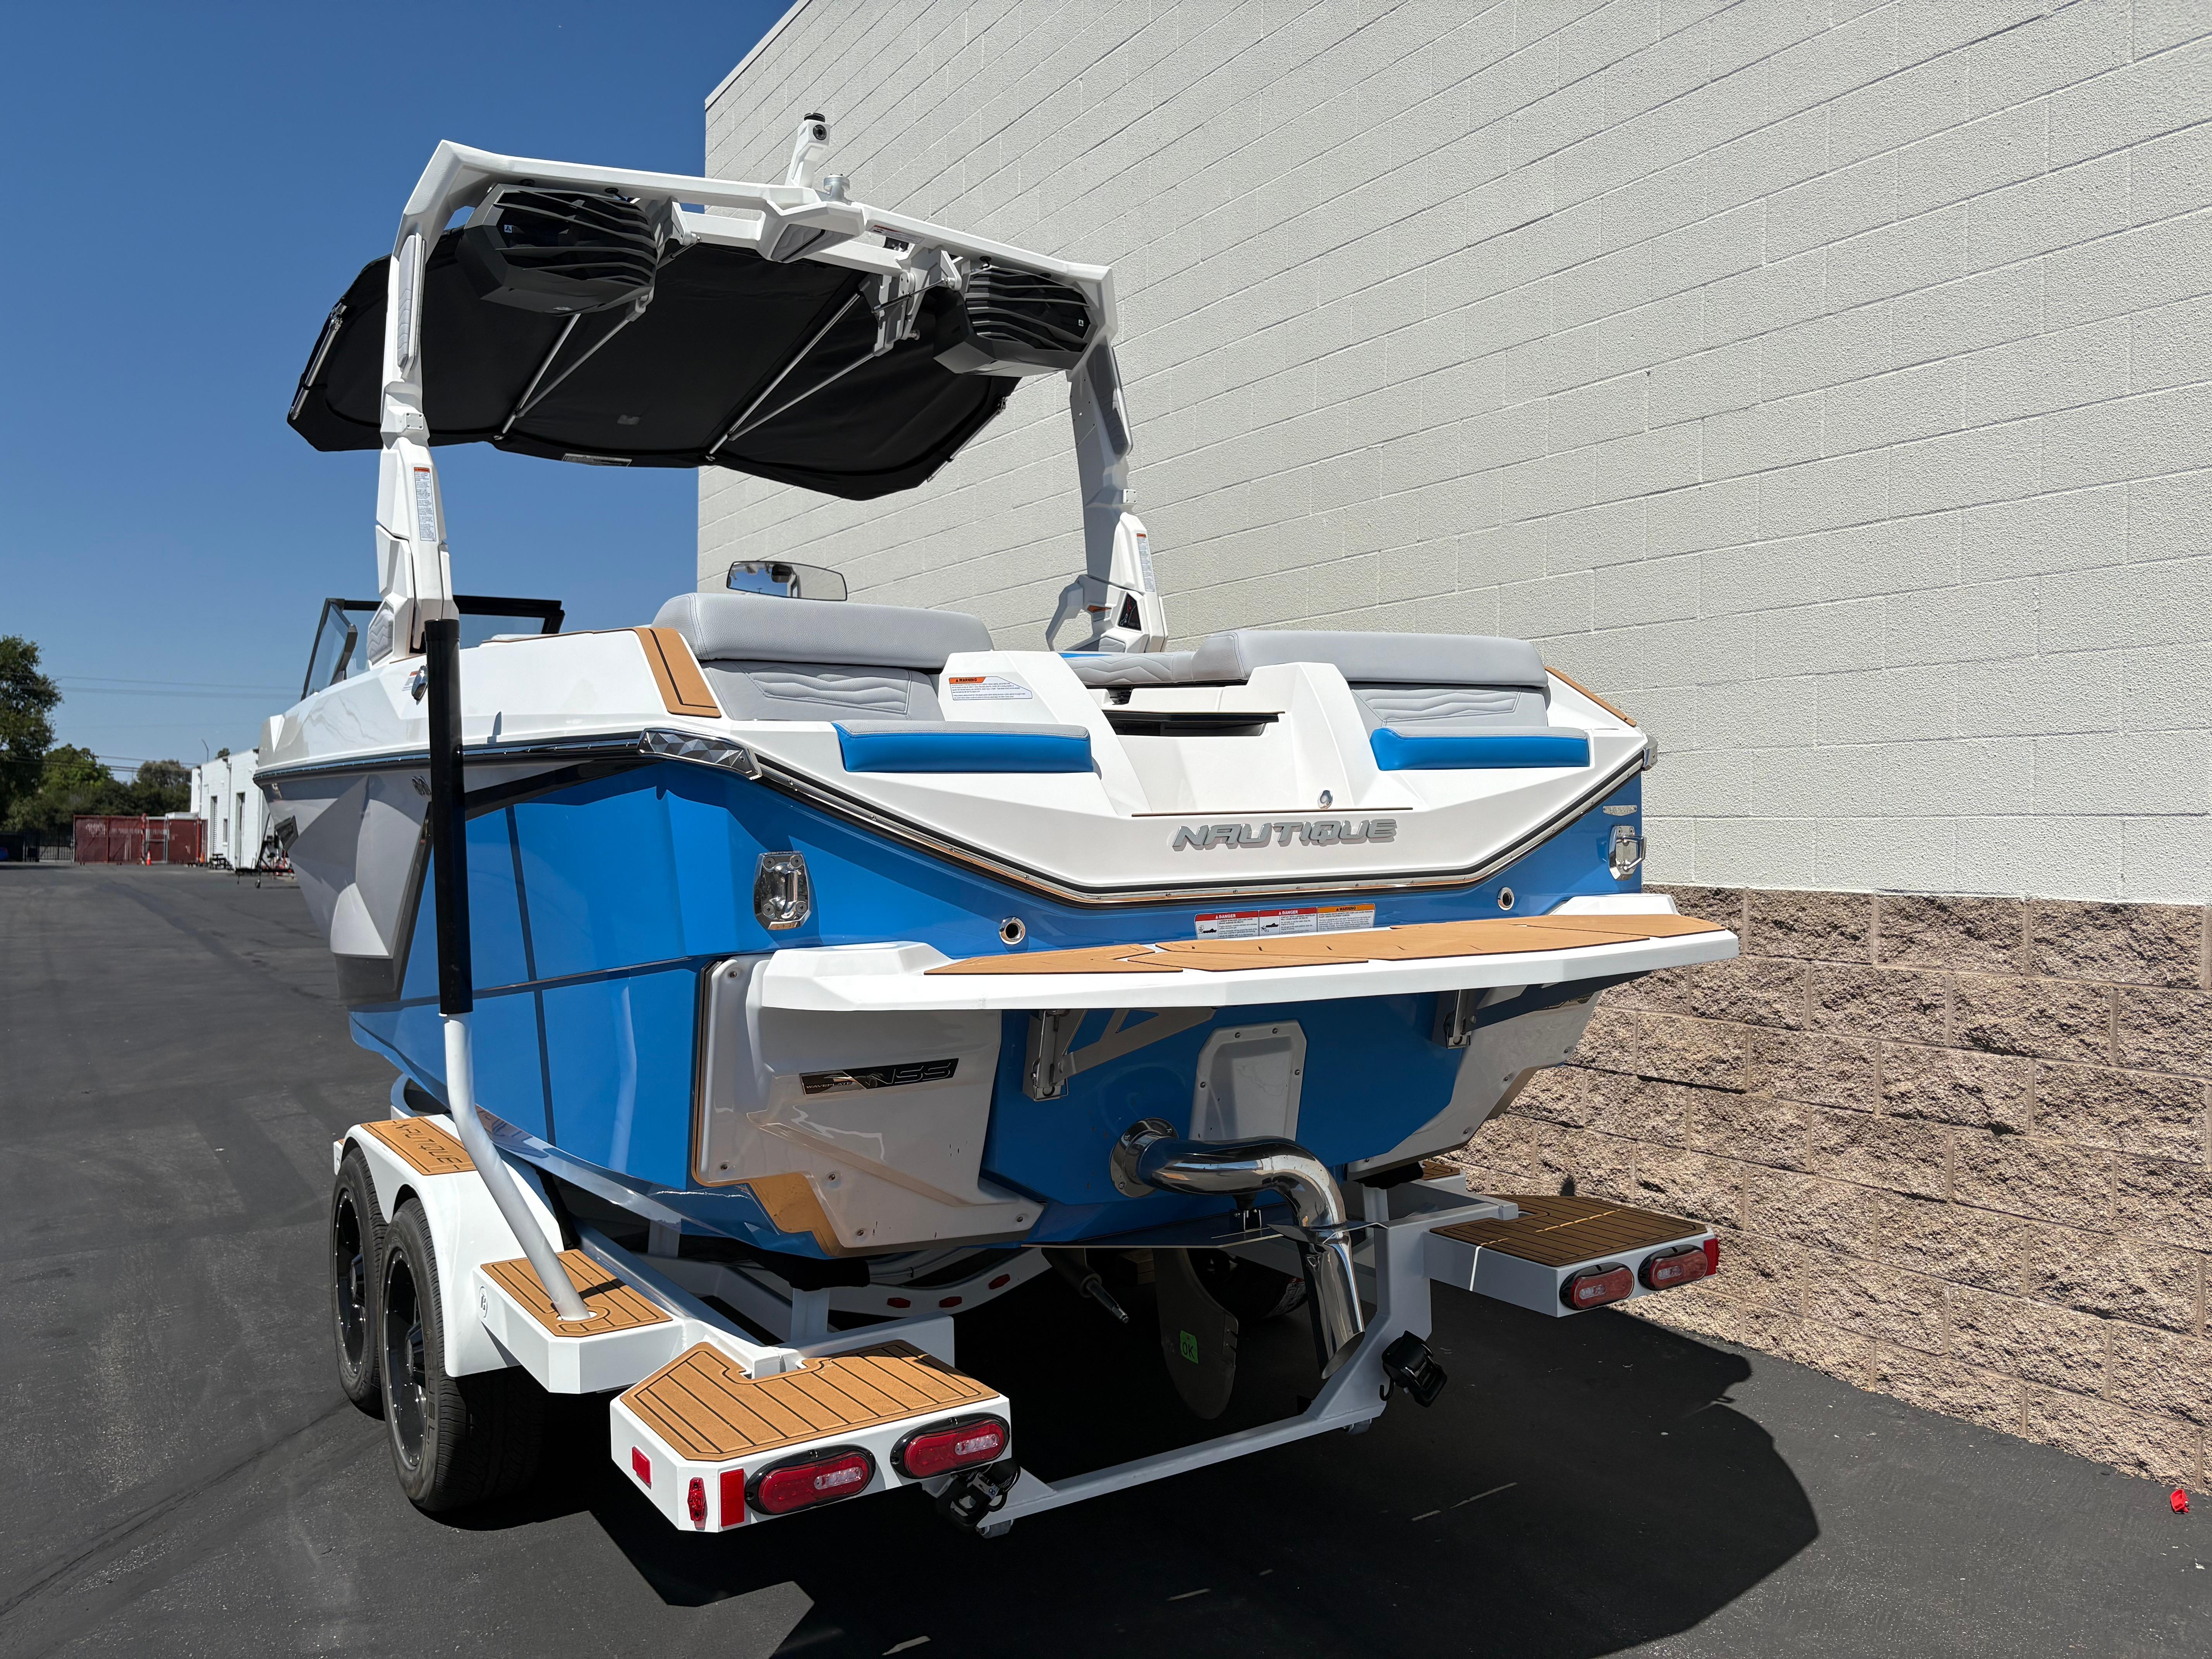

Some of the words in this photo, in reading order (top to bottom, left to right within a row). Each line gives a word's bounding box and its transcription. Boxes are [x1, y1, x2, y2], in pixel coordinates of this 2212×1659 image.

[1172, 819, 1397, 851] NAUTIQUE
[865, 1062, 951, 1086] NSS
[395, 1124, 463, 1163] NAUTIQUE
[1182, 1342, 1195, 1359] OK
